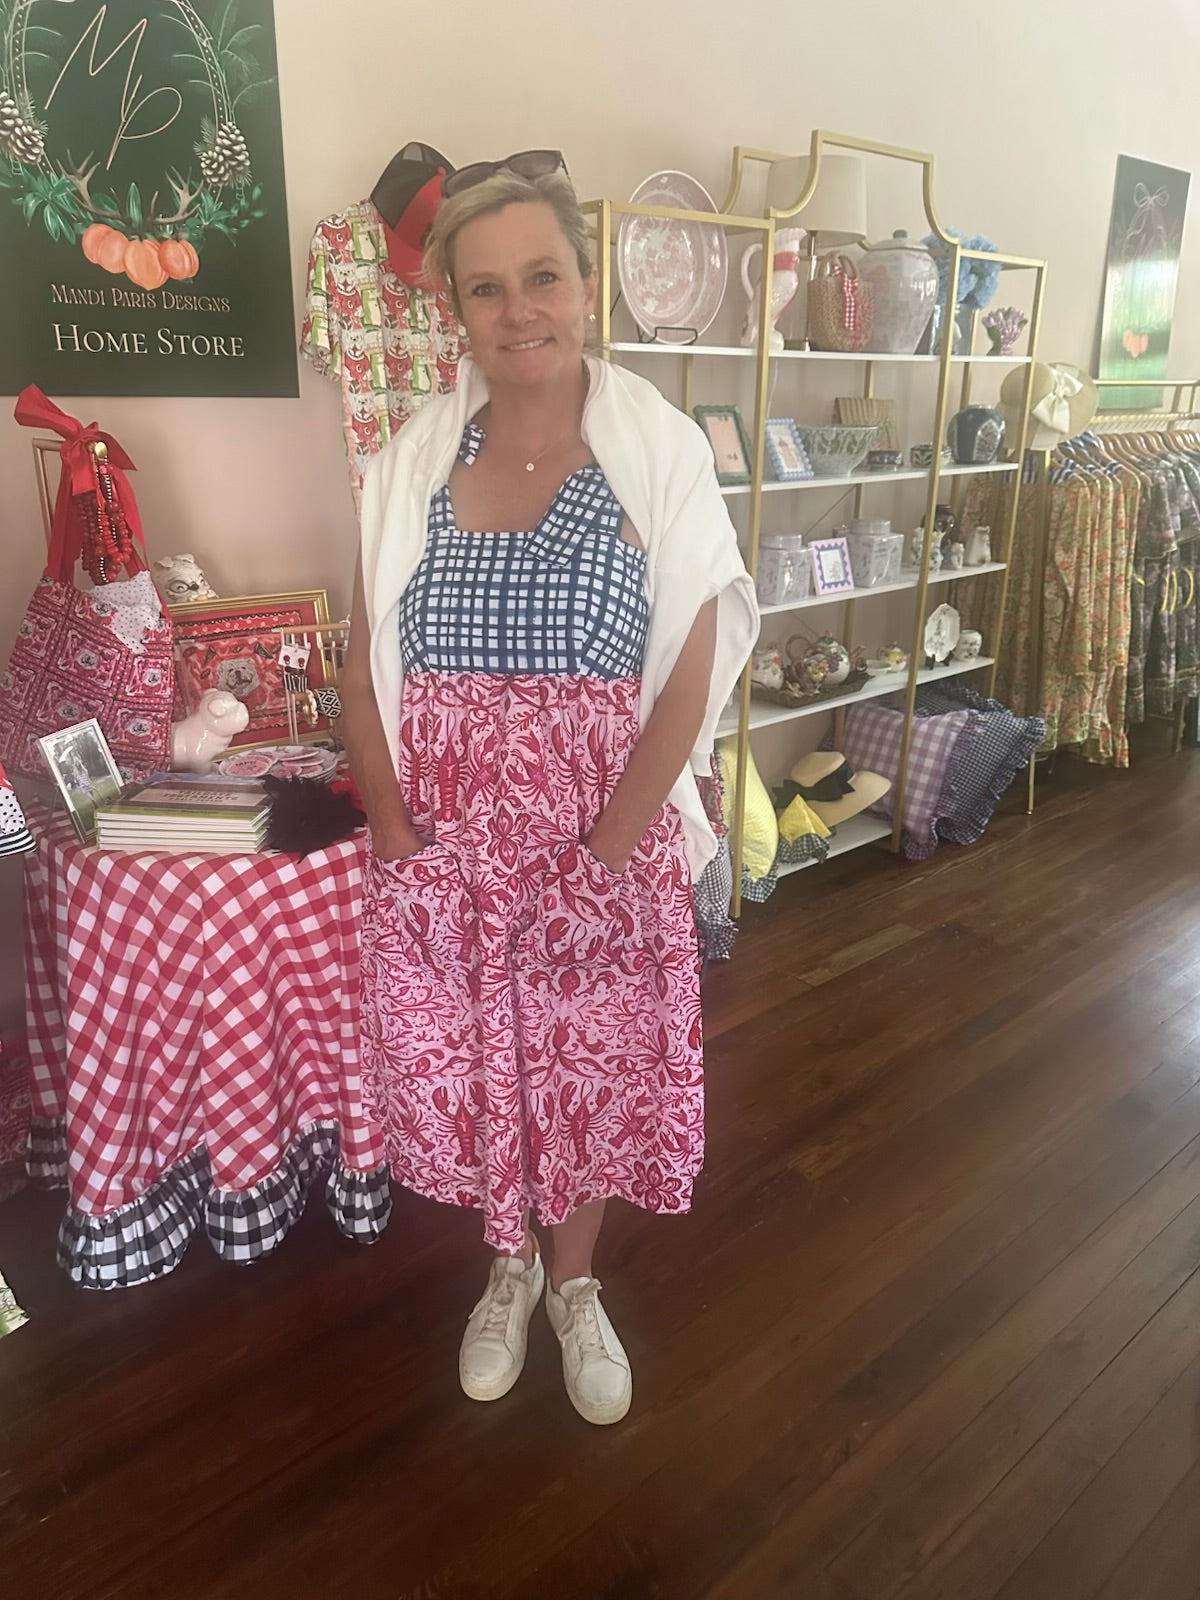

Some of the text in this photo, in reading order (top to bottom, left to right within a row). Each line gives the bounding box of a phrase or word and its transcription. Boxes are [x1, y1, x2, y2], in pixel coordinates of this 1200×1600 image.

[51, 284, 106, 306] MANDI
[111, 287, 157, 309] PARIS
[52, 323, 245, 357] HOME STORE
